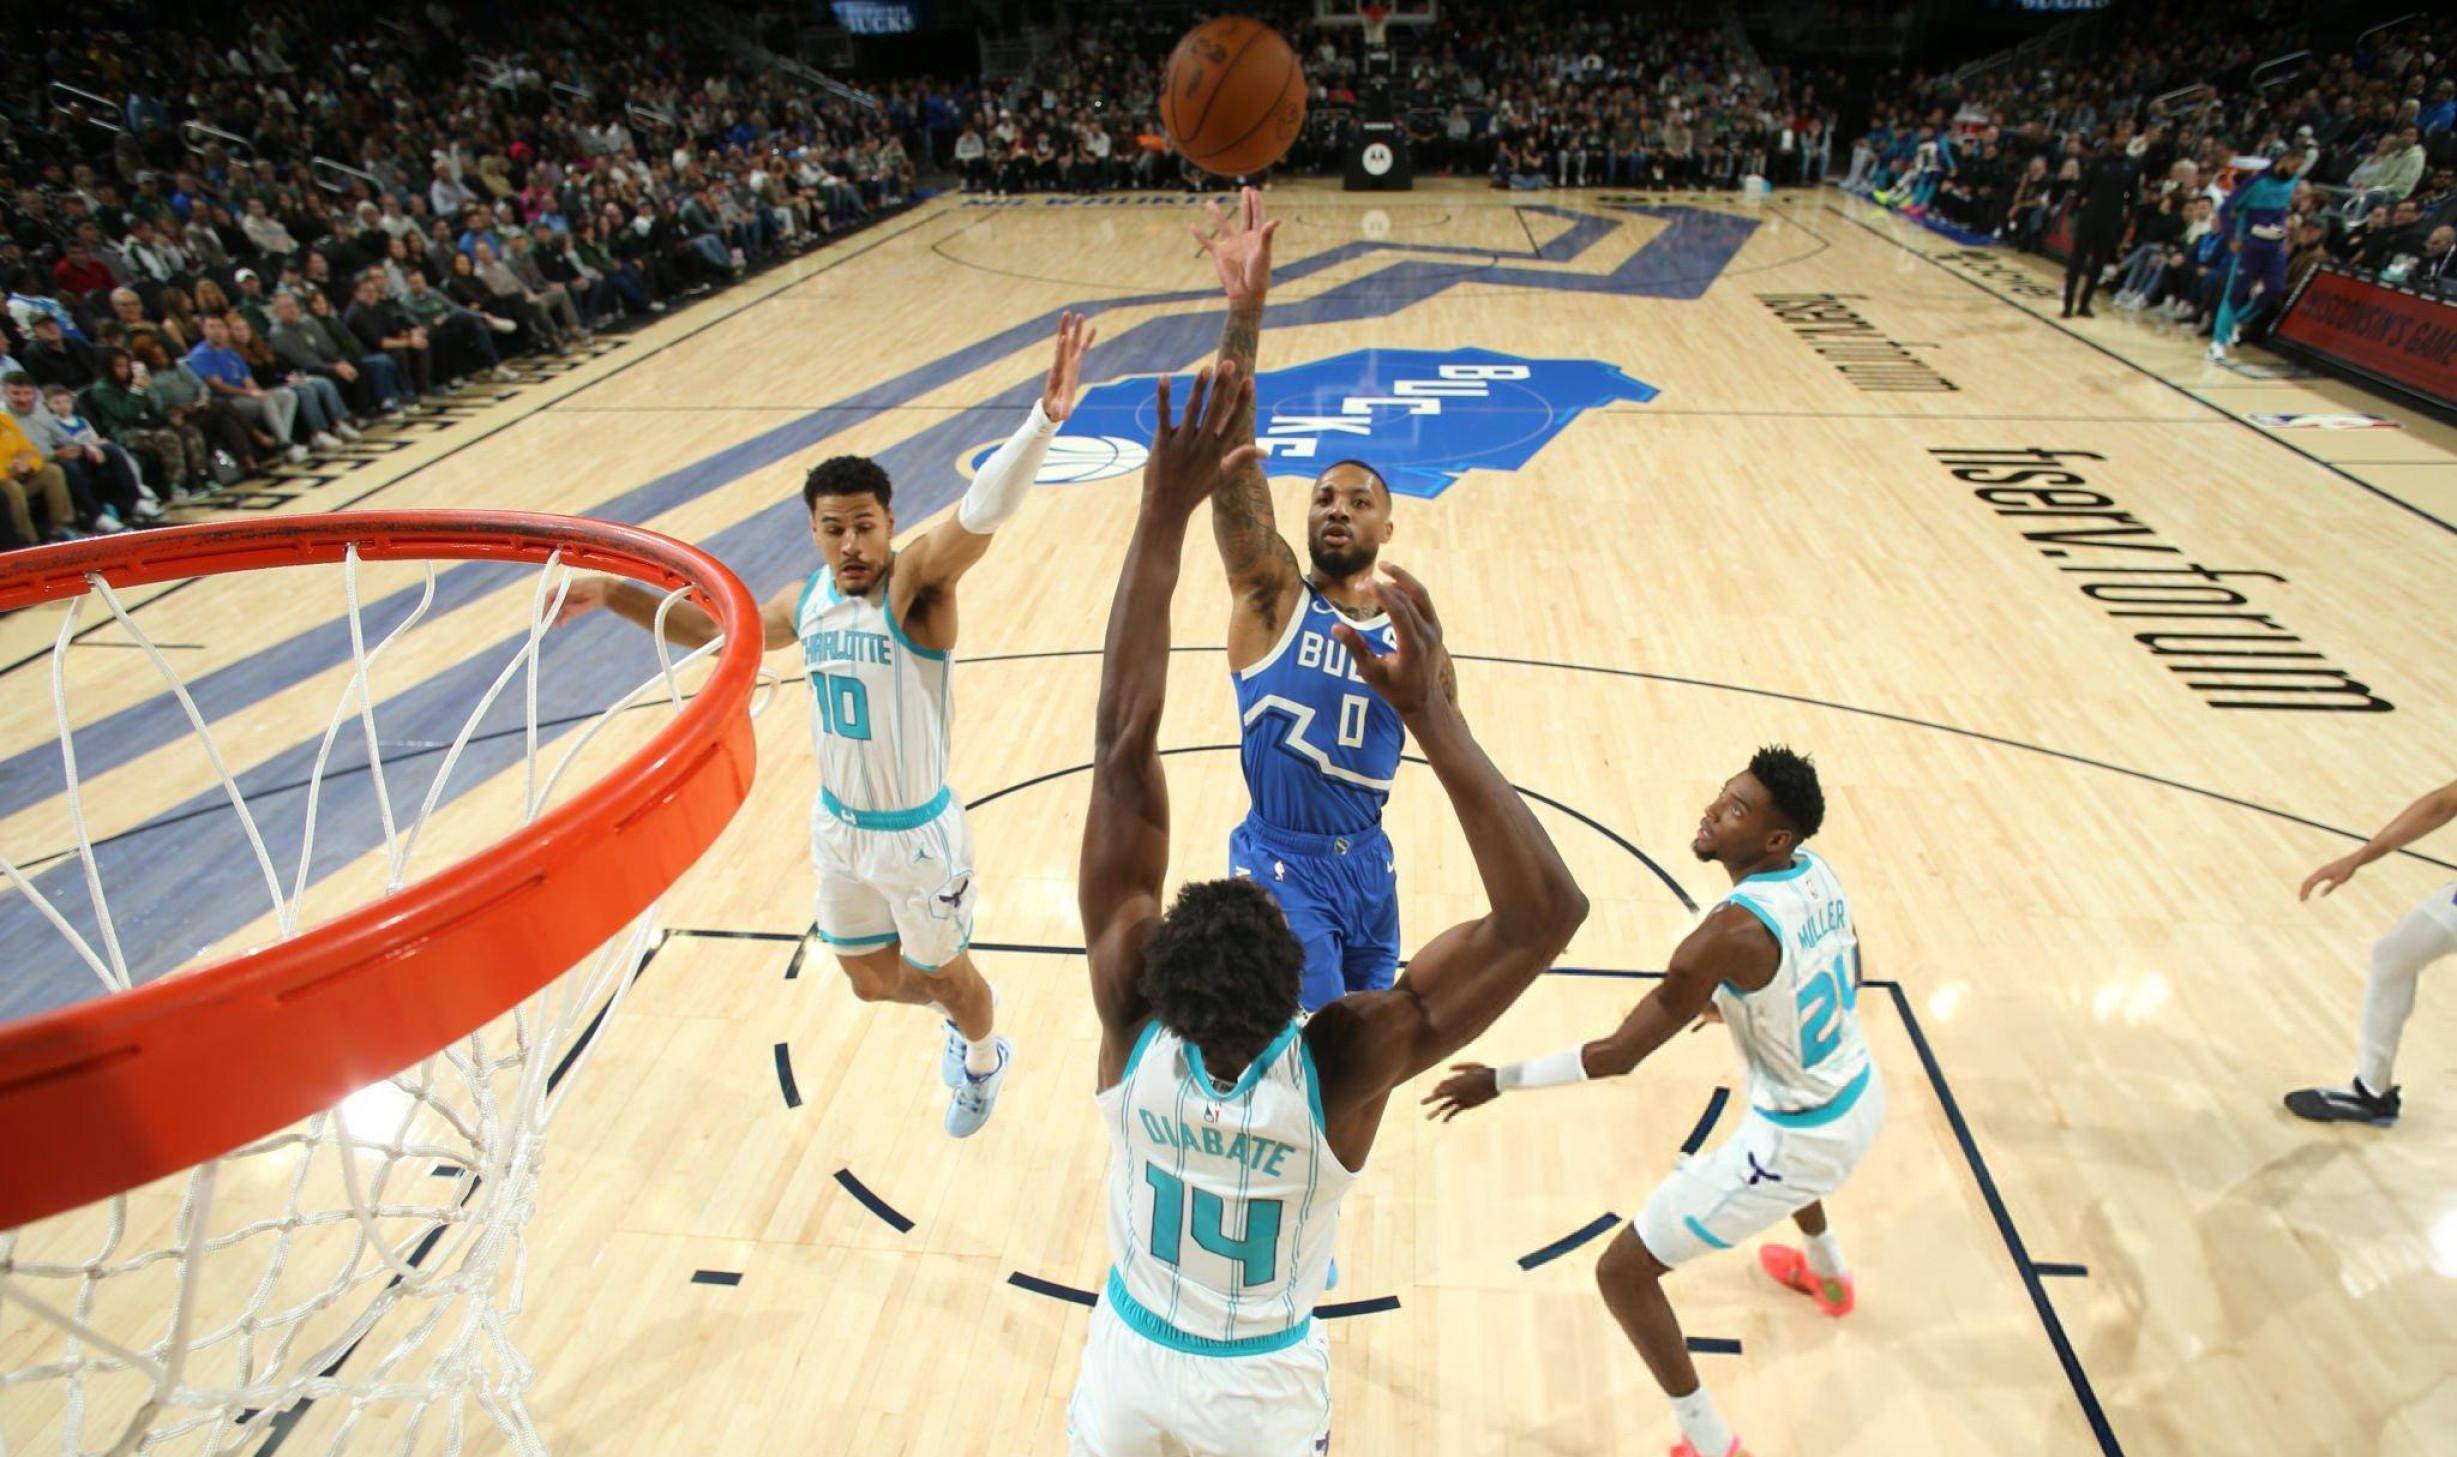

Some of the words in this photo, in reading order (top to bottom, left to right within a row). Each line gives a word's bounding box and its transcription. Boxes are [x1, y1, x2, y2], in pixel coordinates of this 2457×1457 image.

[1927, 447, 2395, 712] fiserv.forum
[811, 671, 871, 741] 10
[1338, 693, 1369, 748] 0
[1797, 899, 1845, 951] MILLER
[1139, 1107, 1296, 1178] DIABATE
[1146, 1160, 1283, 1288] 14
